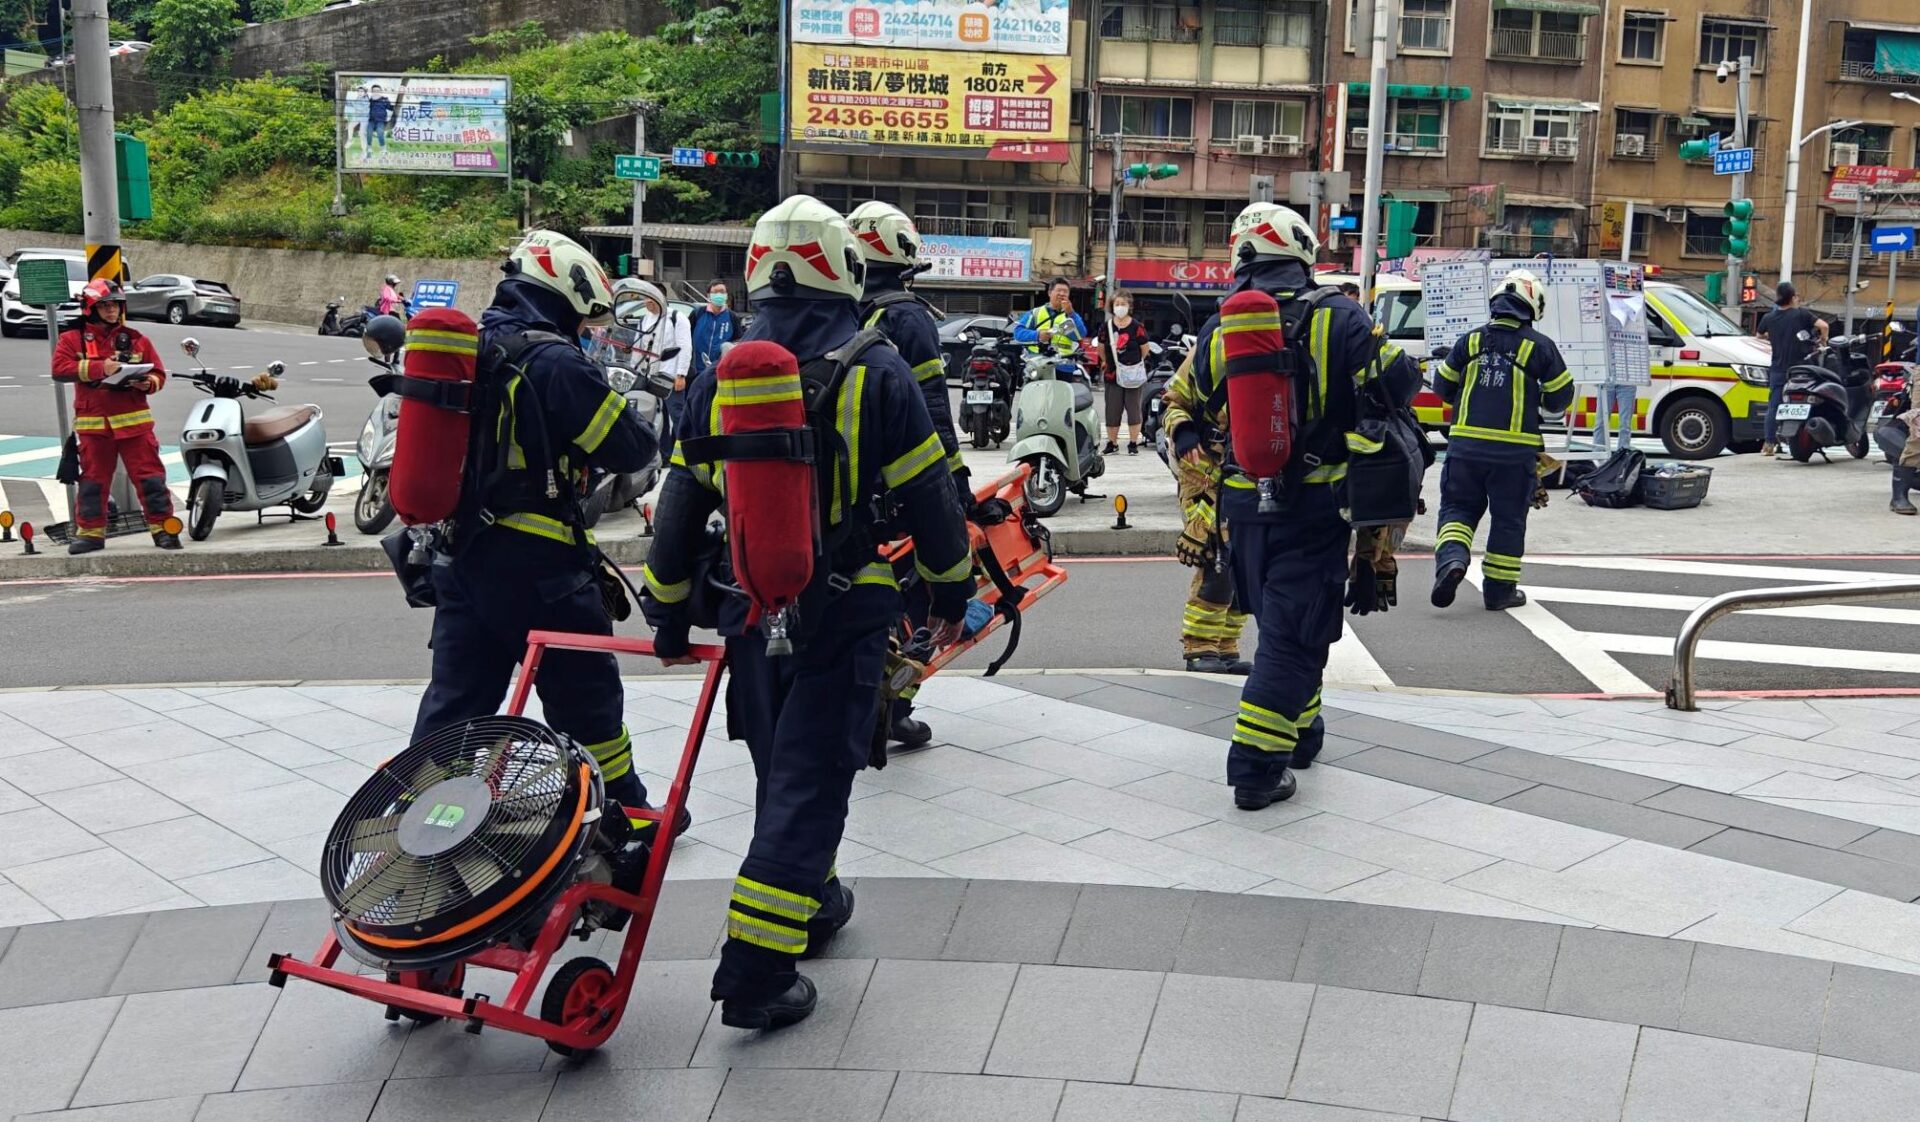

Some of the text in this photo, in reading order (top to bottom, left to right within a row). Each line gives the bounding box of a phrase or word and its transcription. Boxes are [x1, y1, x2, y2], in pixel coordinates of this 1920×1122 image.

[884, 12, 953, 28] 24244714
[993, 17, 1061, 33] 24211628
[982, 62, 1007, 76] 前方
[808, 68, 949, 95] 新橫濱/夢悅城
[964, 77, 1024, 93] 180公尺
[807, 107, 949, 129] 2436-6655
[1204, 265, 1232, 280] KY
[1480, 367, 1506, 387] 消防
[1270, 392, 1285, 455] 基隆市
